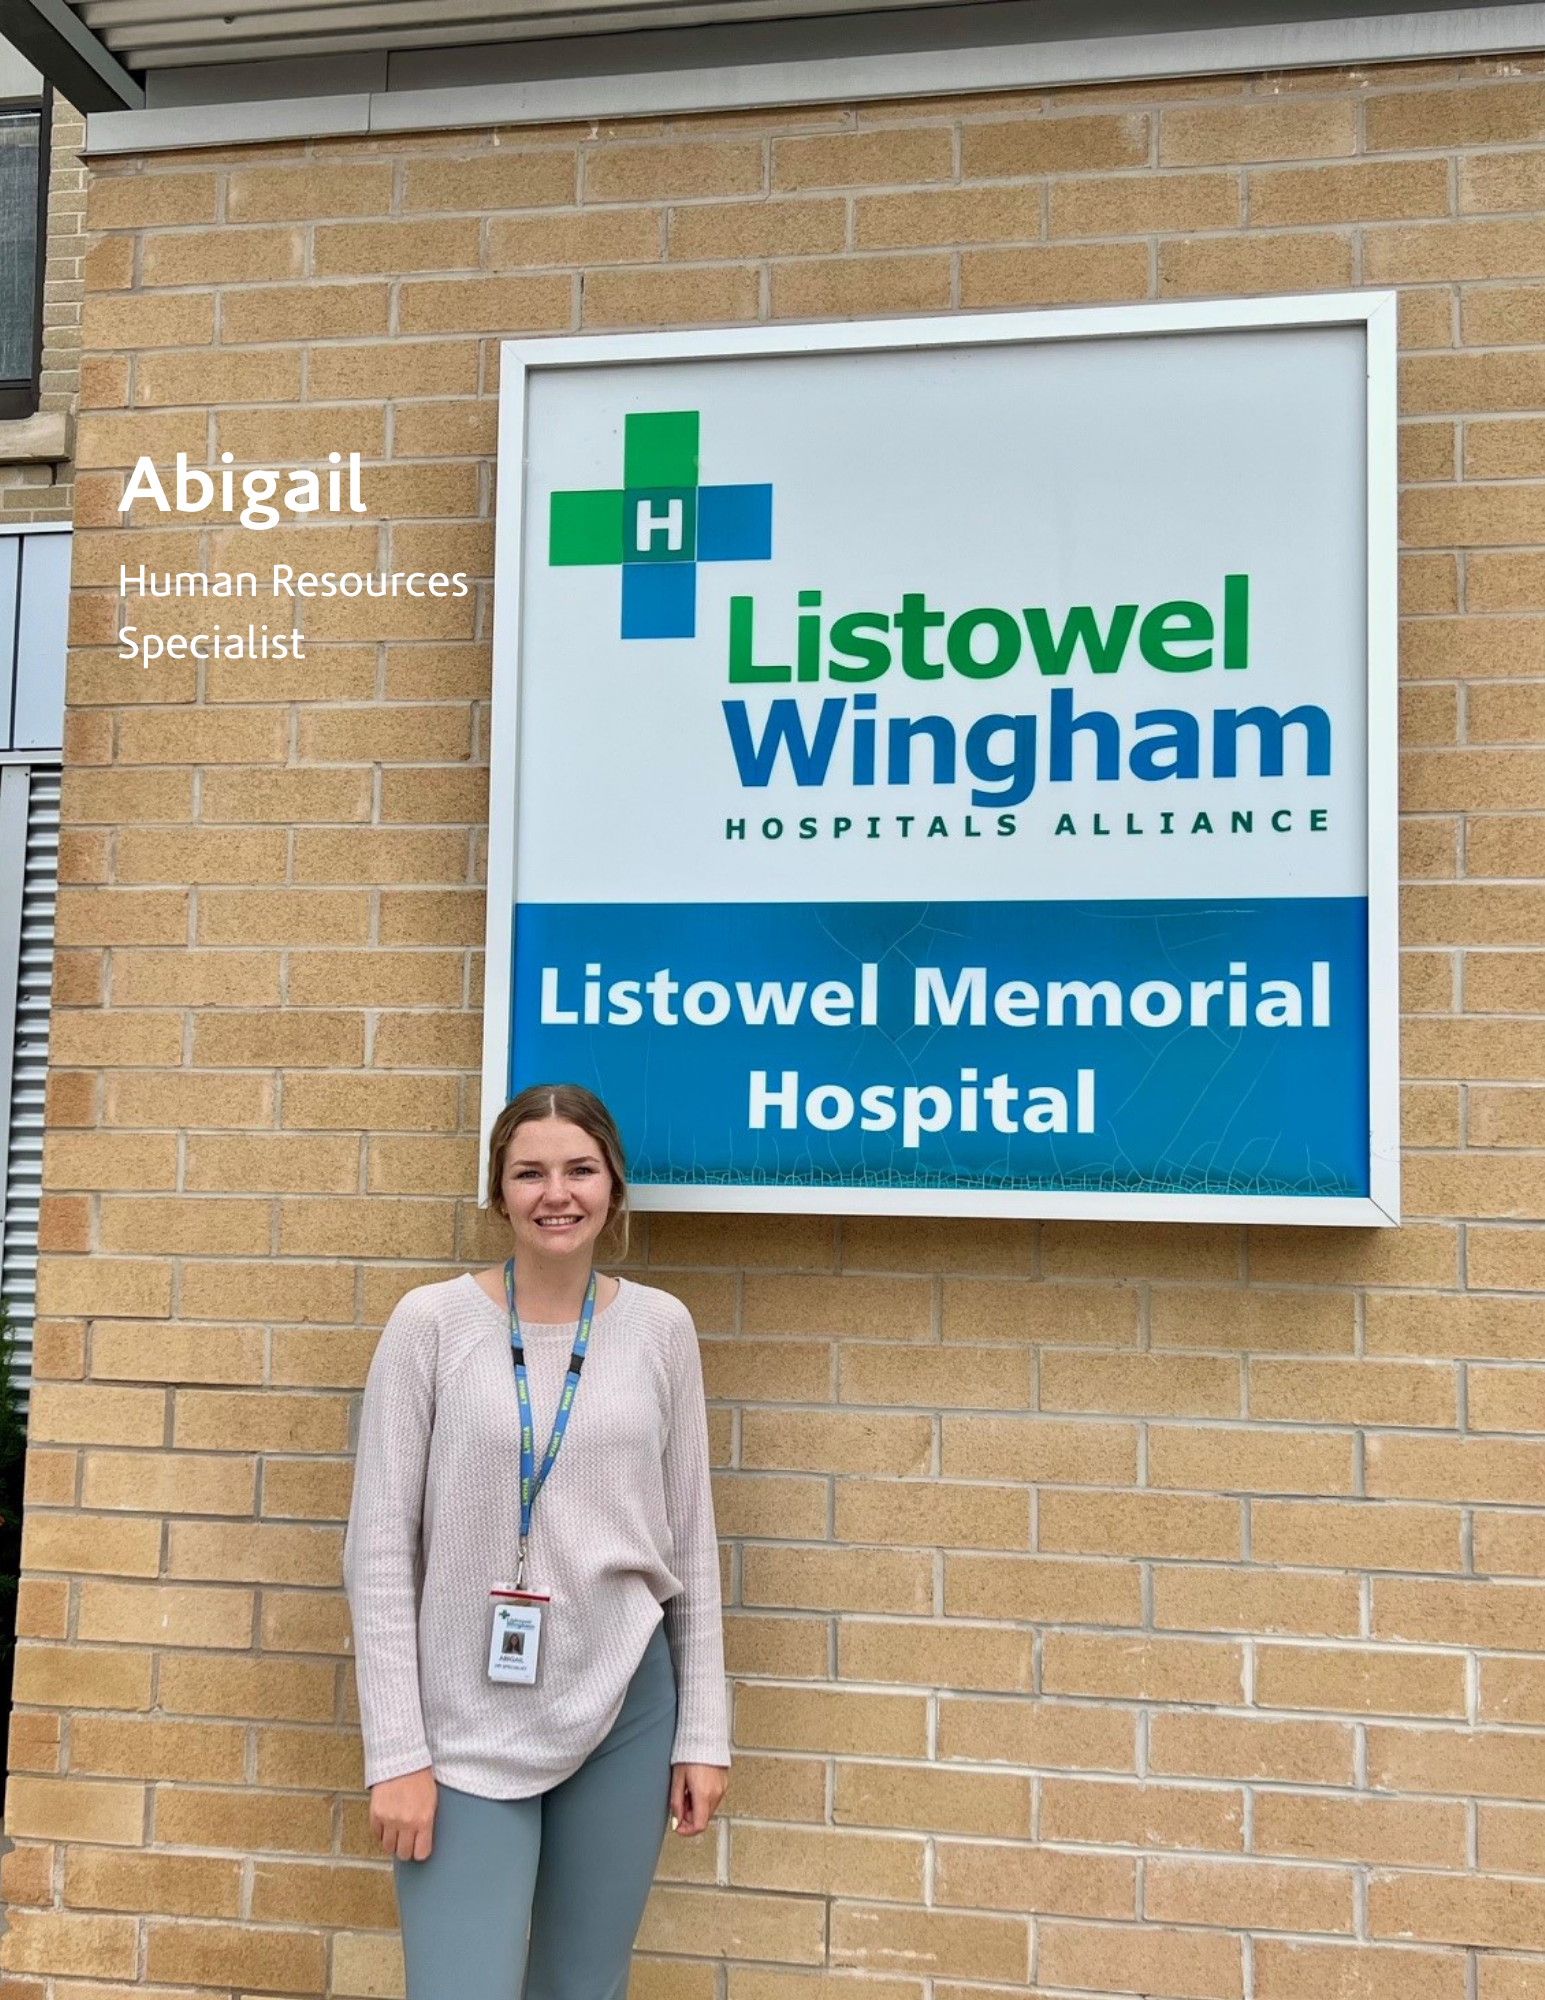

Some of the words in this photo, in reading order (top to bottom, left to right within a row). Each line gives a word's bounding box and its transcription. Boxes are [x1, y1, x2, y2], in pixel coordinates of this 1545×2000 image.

[636, 500, 683, 552] H
[728, 575, 1249, 684] Listowel
[722, 688, 1331, 808] Wingham
[726, 813, 1016, 840] HOSPITALS
[1054, 809, 1328, 836] ALLIANCE
[541, 963, 878, 1026] Listowel
[914, 962, 1330, 1027] Memorial
[749, 1068, 1094, 1148] Hospital
[518, 1380, 527, 1404] LWHA
[562, 1386, 572, 1410] LWHA
[523, 1425, 531, 1454] LWHA
[548, 1432, 561, 1457] LWHA
[522, 1477, 530, 1506] LWHA
